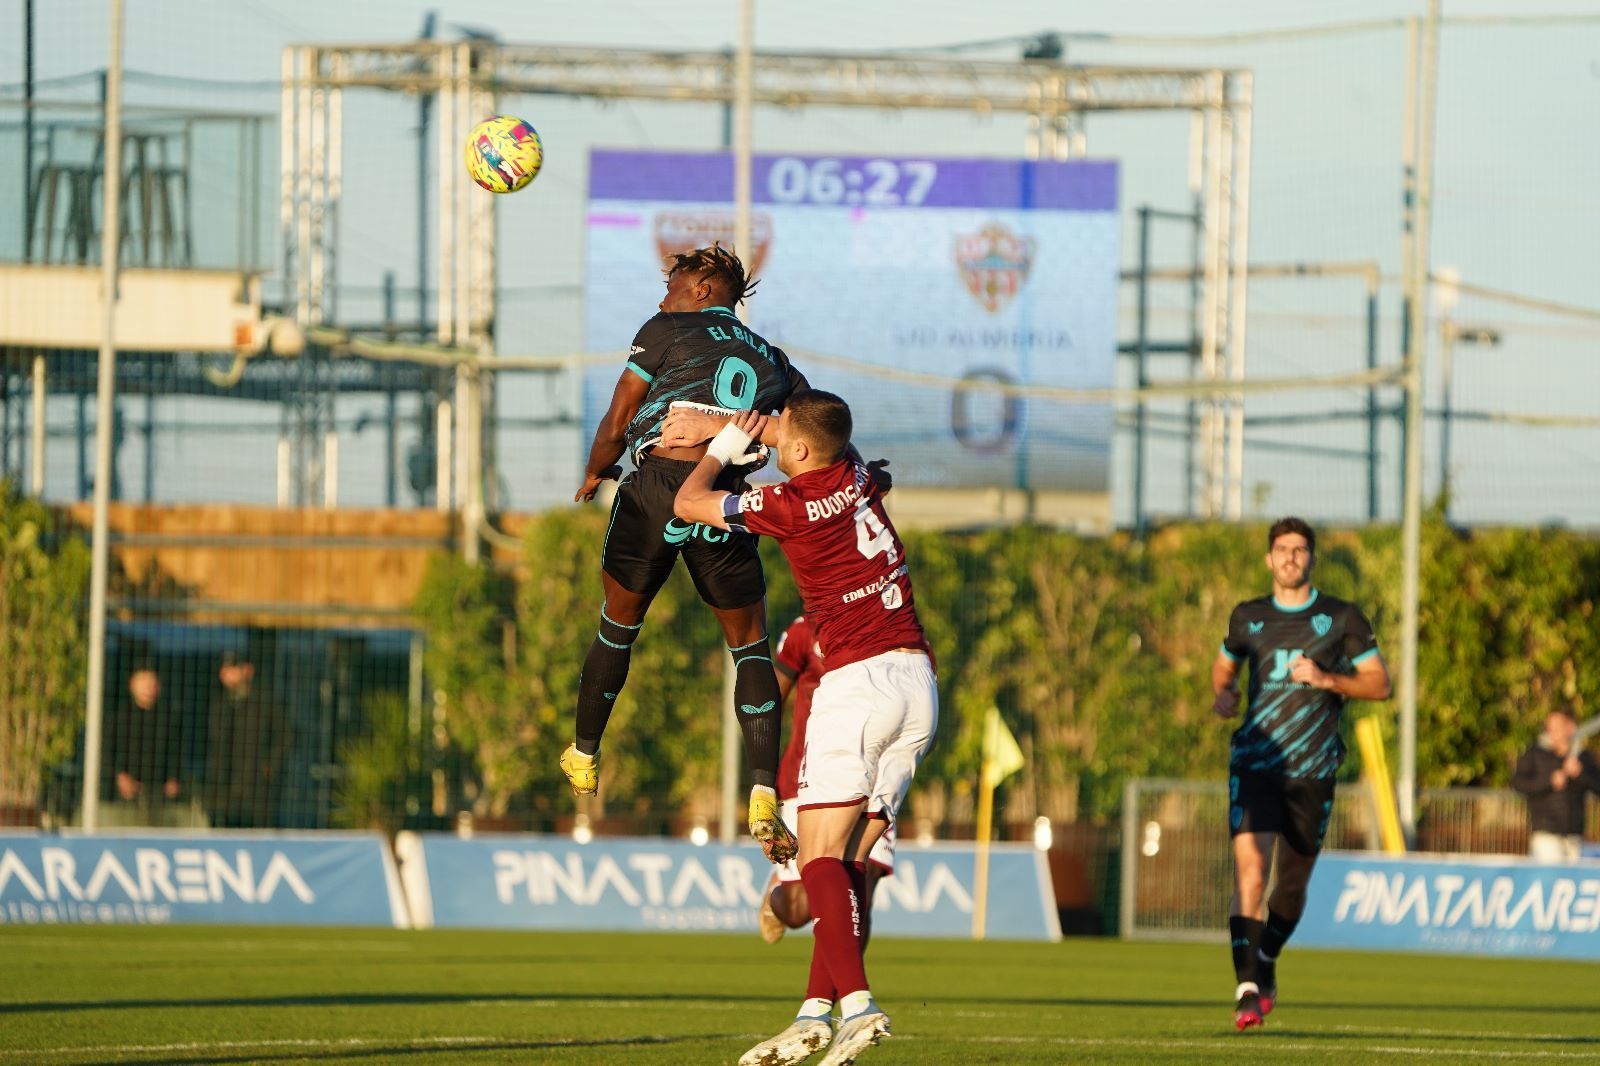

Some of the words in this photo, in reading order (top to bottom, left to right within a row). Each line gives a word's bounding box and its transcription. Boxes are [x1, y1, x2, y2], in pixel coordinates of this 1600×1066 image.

[767, 157, 938, 206] 06:27
[706, 326, 732, 341] EL
[951, 366, 1023, 456] 0
[853, 496, 900, 566] 4
